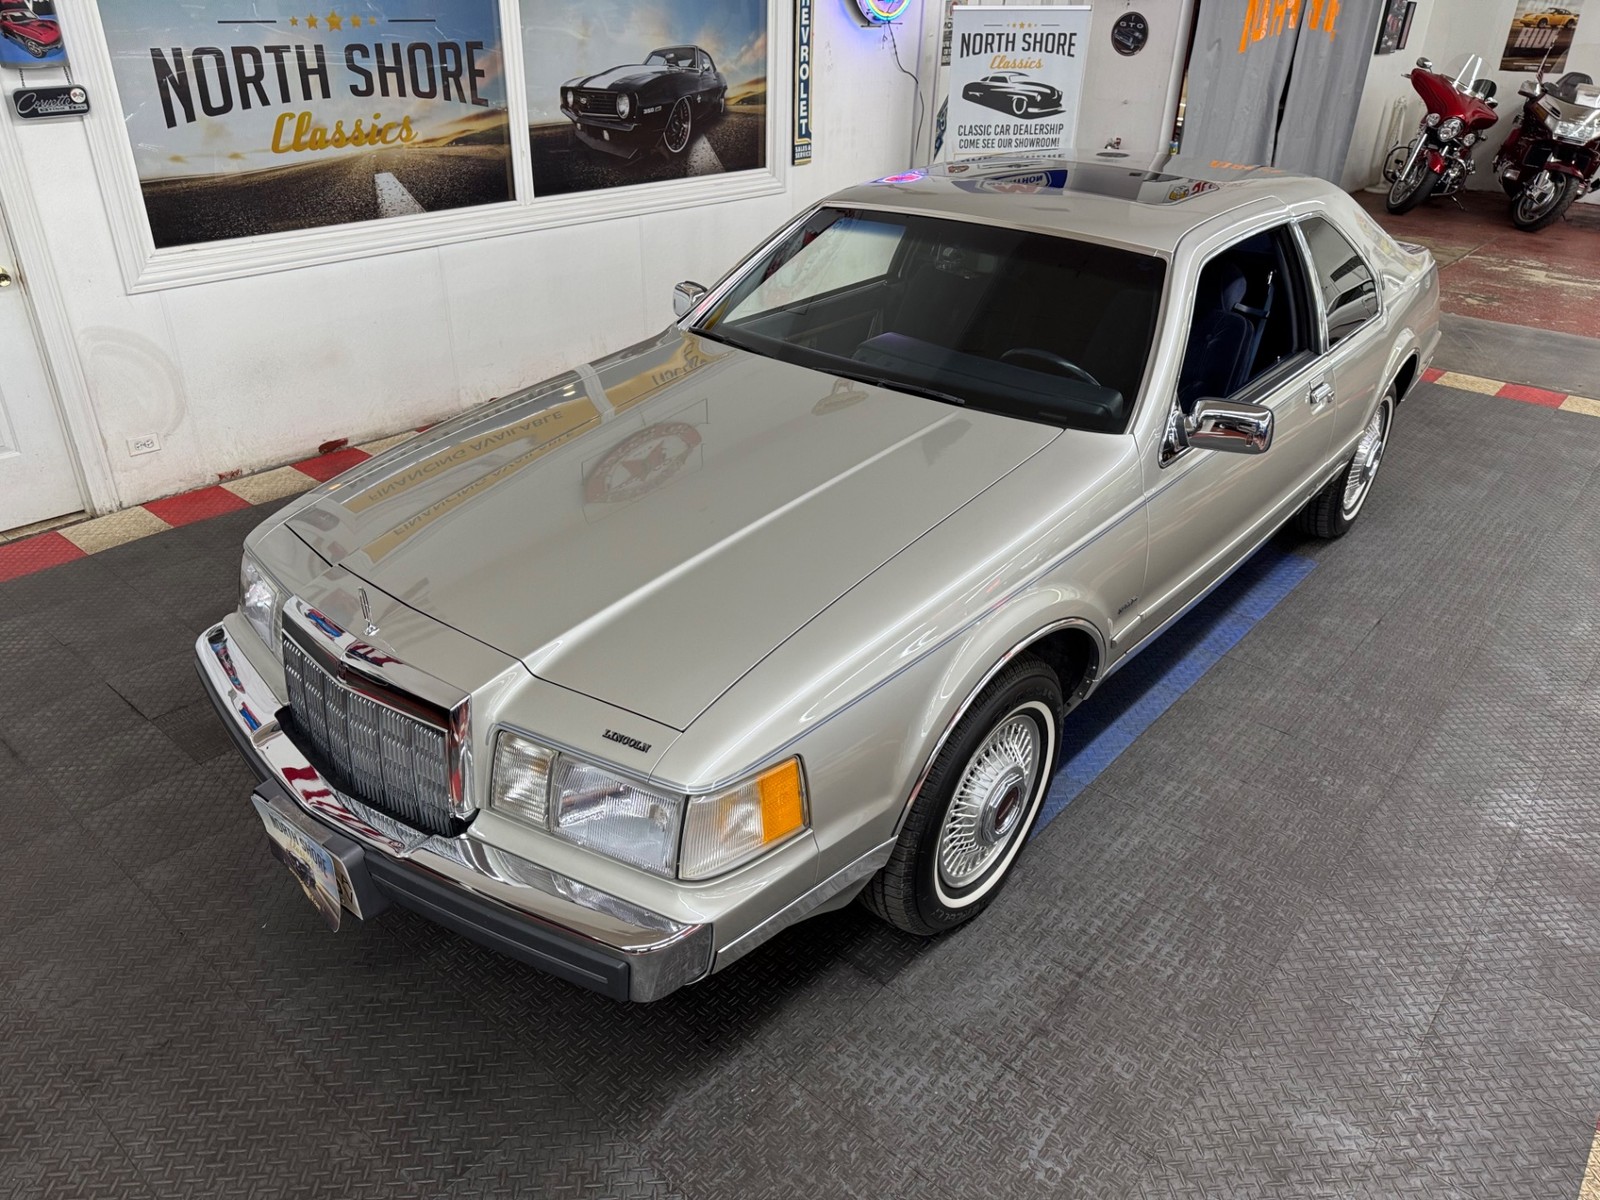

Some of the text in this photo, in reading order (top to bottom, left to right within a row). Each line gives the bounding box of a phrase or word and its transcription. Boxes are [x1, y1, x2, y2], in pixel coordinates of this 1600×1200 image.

[1119, 21, 1144, 29] GTO
[960, 32, 1017, 59] NORTH
[1021, 32, 1078, 58] SHORE
[800, 0, 810, 135] EVROLET
[989, 54, 1044, 70] Classics
[150, 40, 490, 129] NORTH SHORE
[17, 92, 73, 114] Corvette
[271, 110, 420, 154] Classics
[958, 123, 1064, 137] CLASSIC CAR DEALERSHIP
[959, 137, 1060, 149] COME SEE OUR SHOWROOM!
[602, 729, 652, 753] LINCOLN
